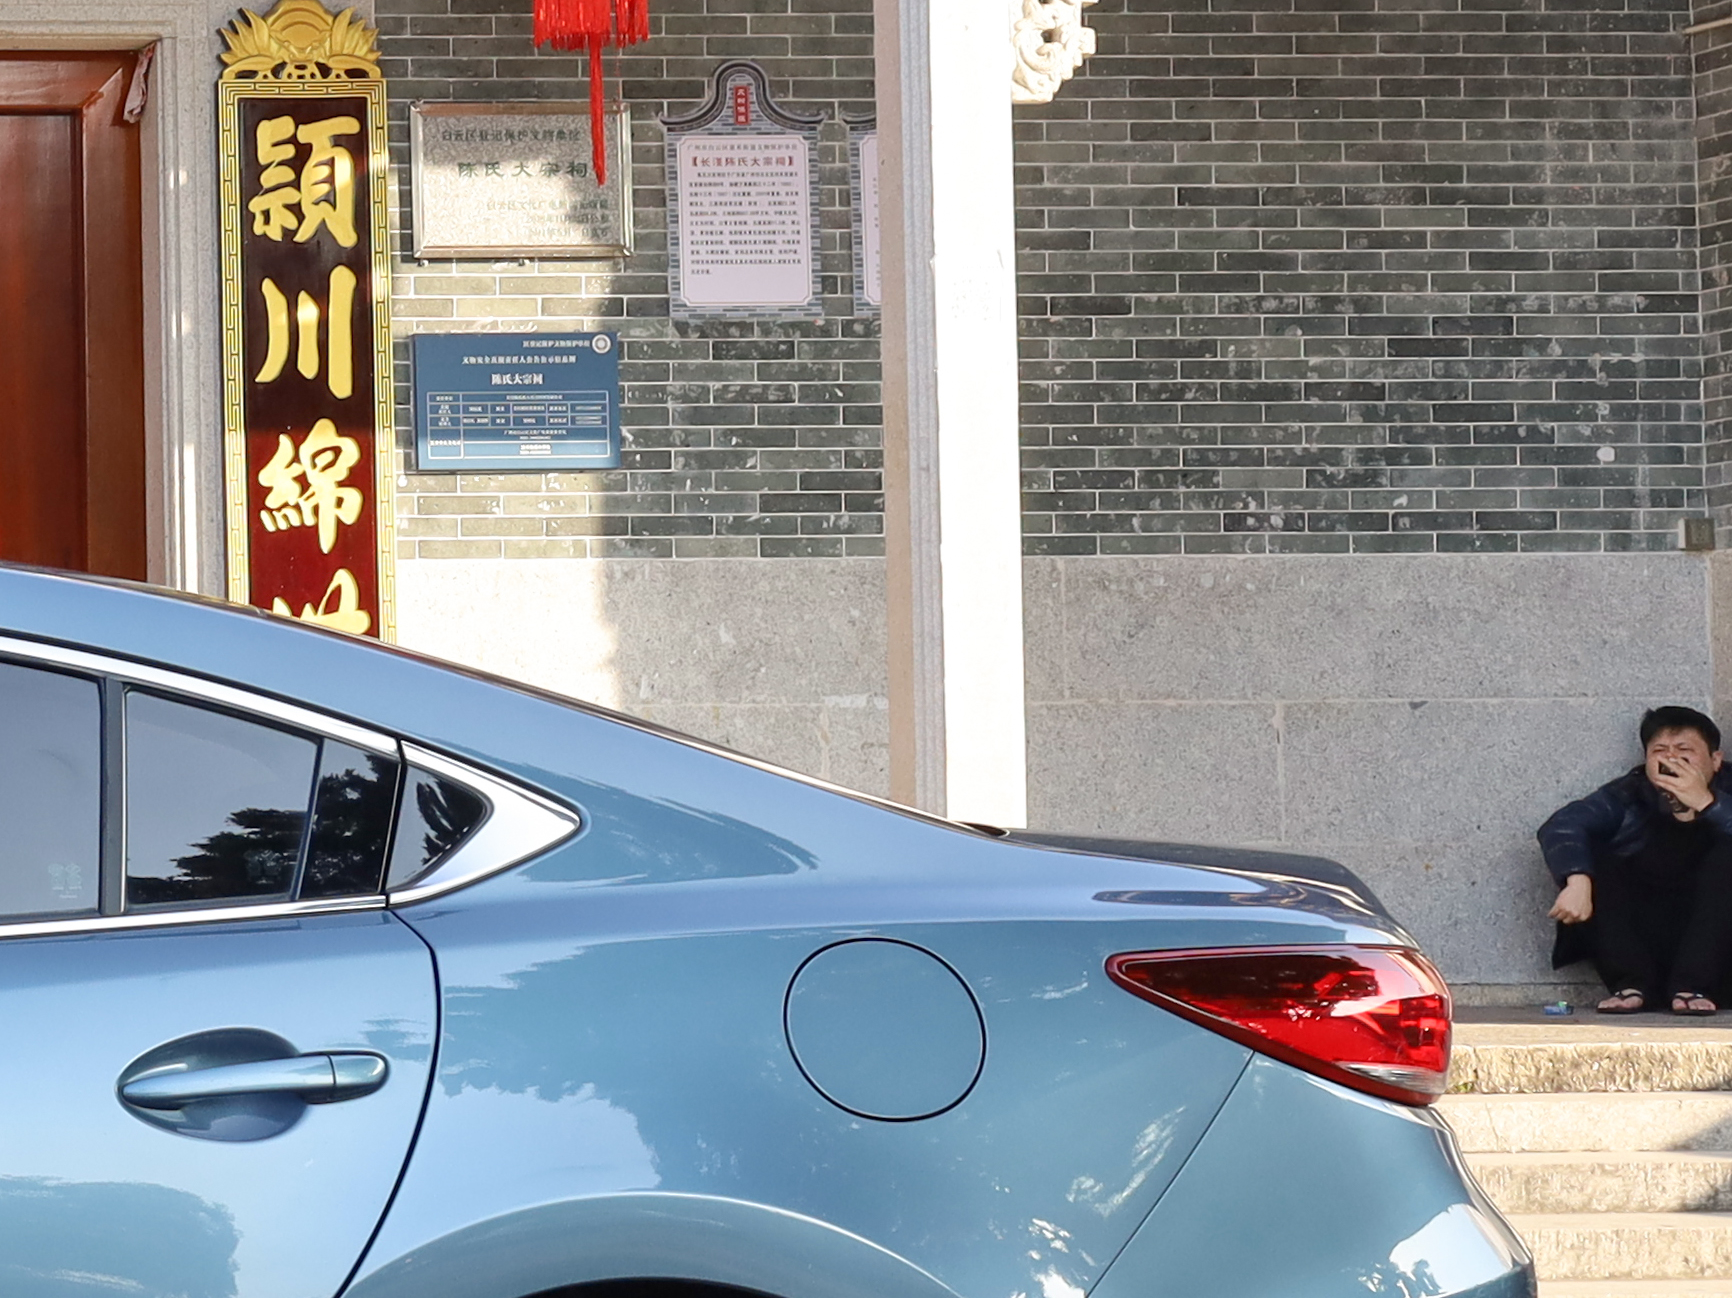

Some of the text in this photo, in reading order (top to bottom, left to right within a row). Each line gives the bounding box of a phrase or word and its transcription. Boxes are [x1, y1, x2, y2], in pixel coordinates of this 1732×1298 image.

[458, 160, 588, 178] 陈氏大宗祠
